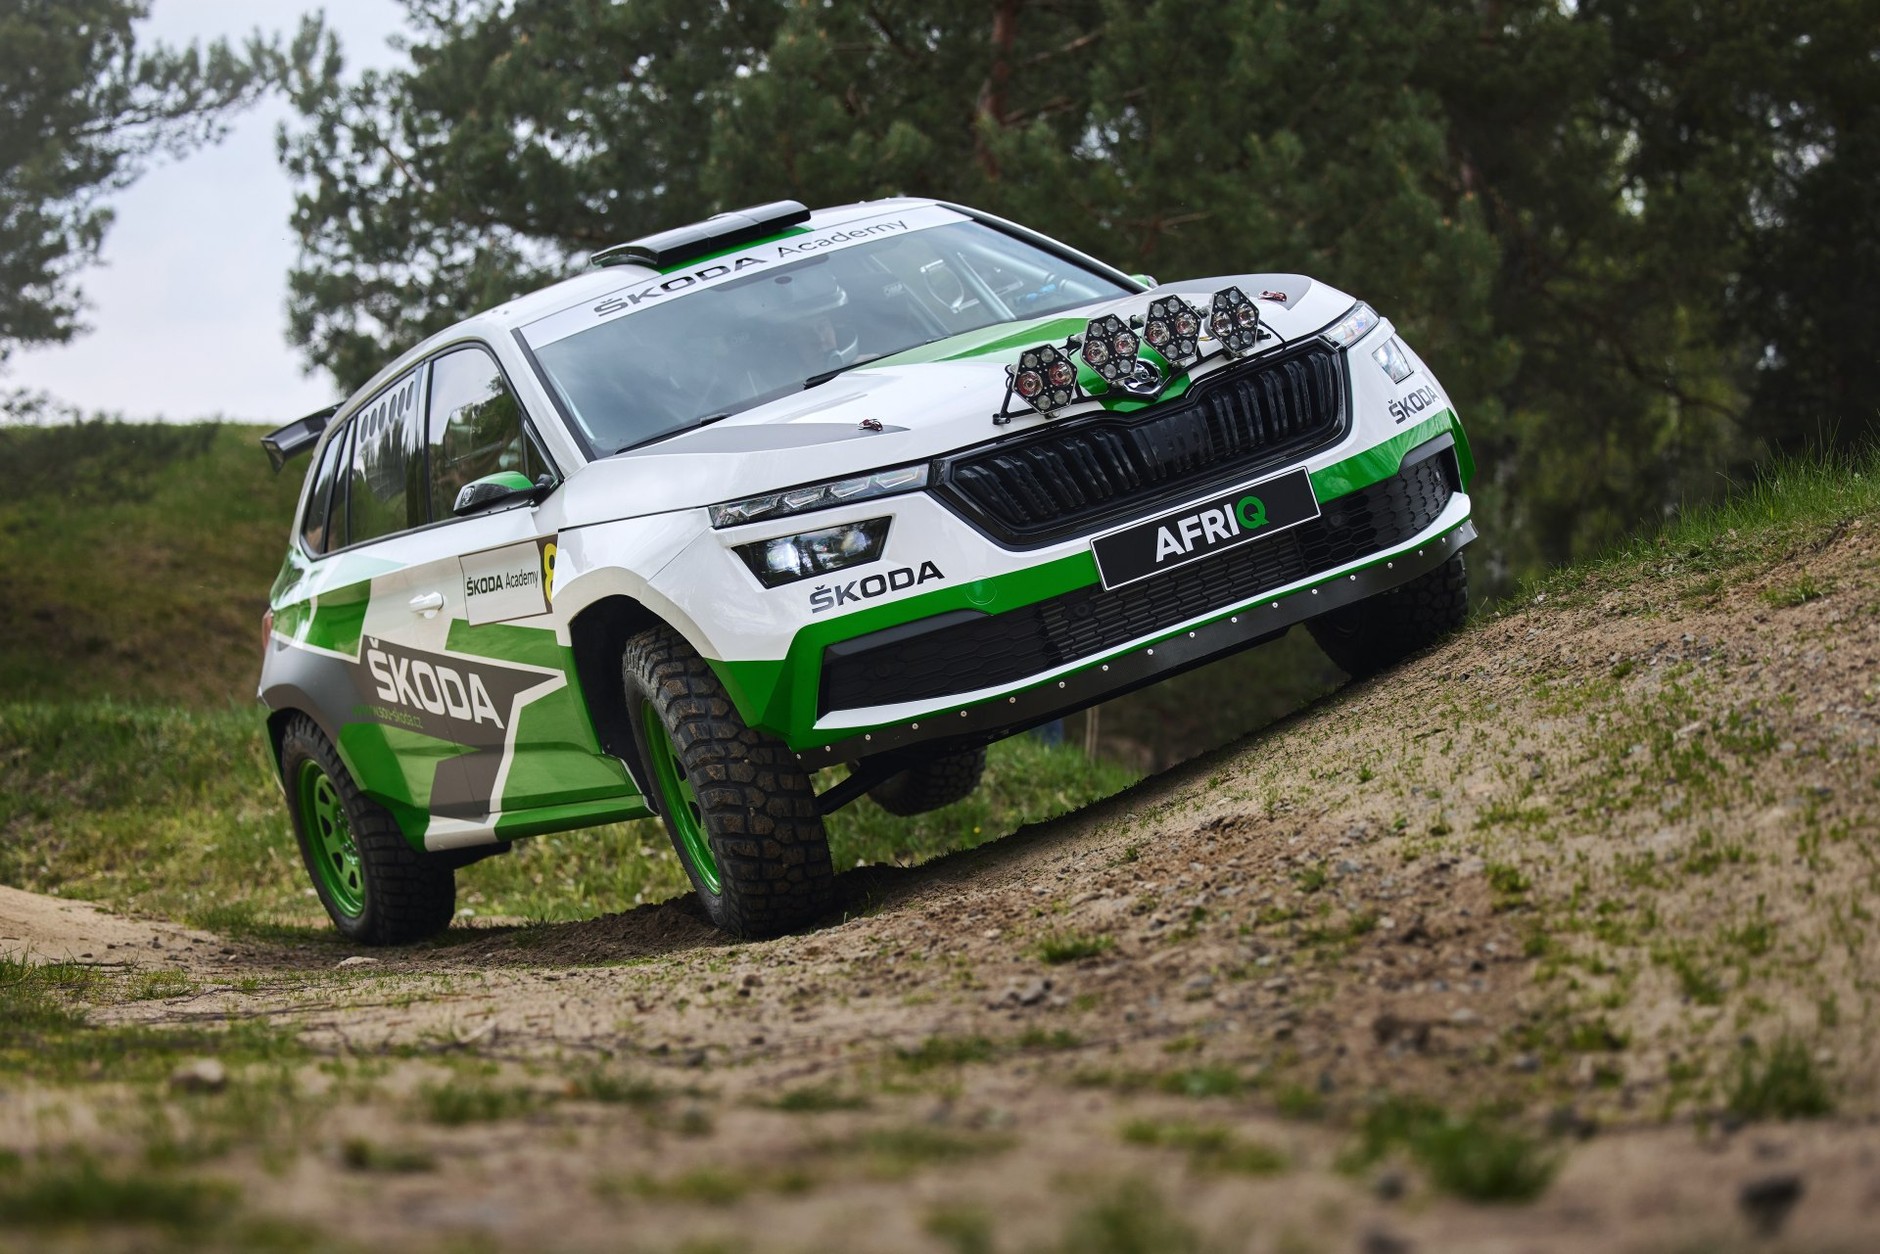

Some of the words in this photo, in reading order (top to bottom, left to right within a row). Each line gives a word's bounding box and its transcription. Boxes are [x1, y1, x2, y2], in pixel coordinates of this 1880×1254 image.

[593, 256, 767, 317] ŠKODA
[776, 219, 908, 259] Academy
[1388, 385, 1440, 425] ŠKODA
[1155, 495, 1270, 563] AFRIQ
[466, 575, 504, 597] ŠKODA
[505, 568, 539, 589] Academy
[809, 560, 945, 614] ŠKODA
[366, 637, 505, 730] ŠKODA
